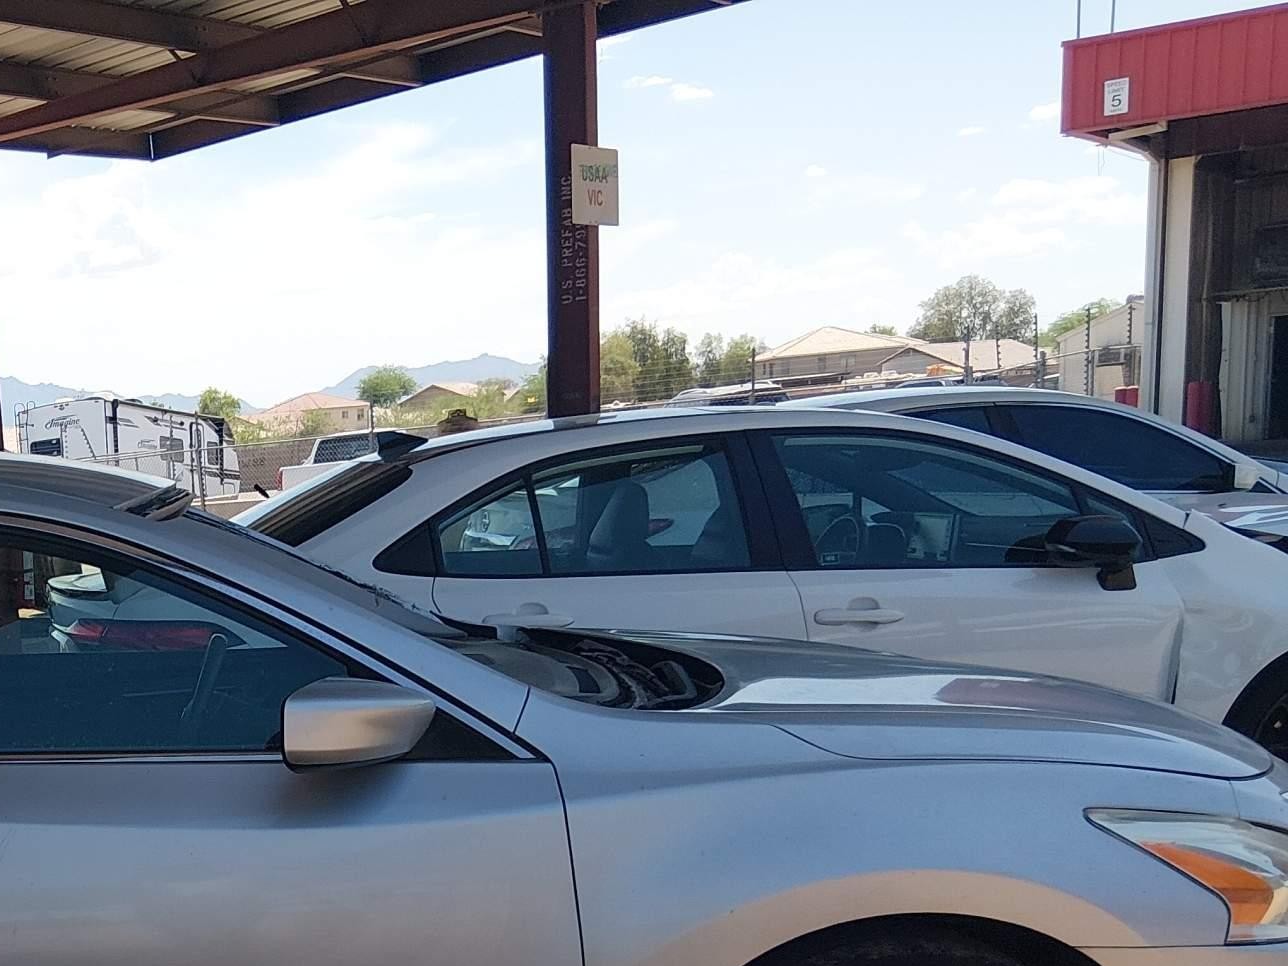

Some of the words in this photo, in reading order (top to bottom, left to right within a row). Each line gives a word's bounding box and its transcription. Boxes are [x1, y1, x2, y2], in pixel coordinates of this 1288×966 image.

[1111, 94, 1122, 107] 5
[581, 165, 609, 184] USAA
[587, 189, 604, 206] VIC
[561, 207, 573, 268] PREFAB
[44, 415, 81, 431] Imagine
